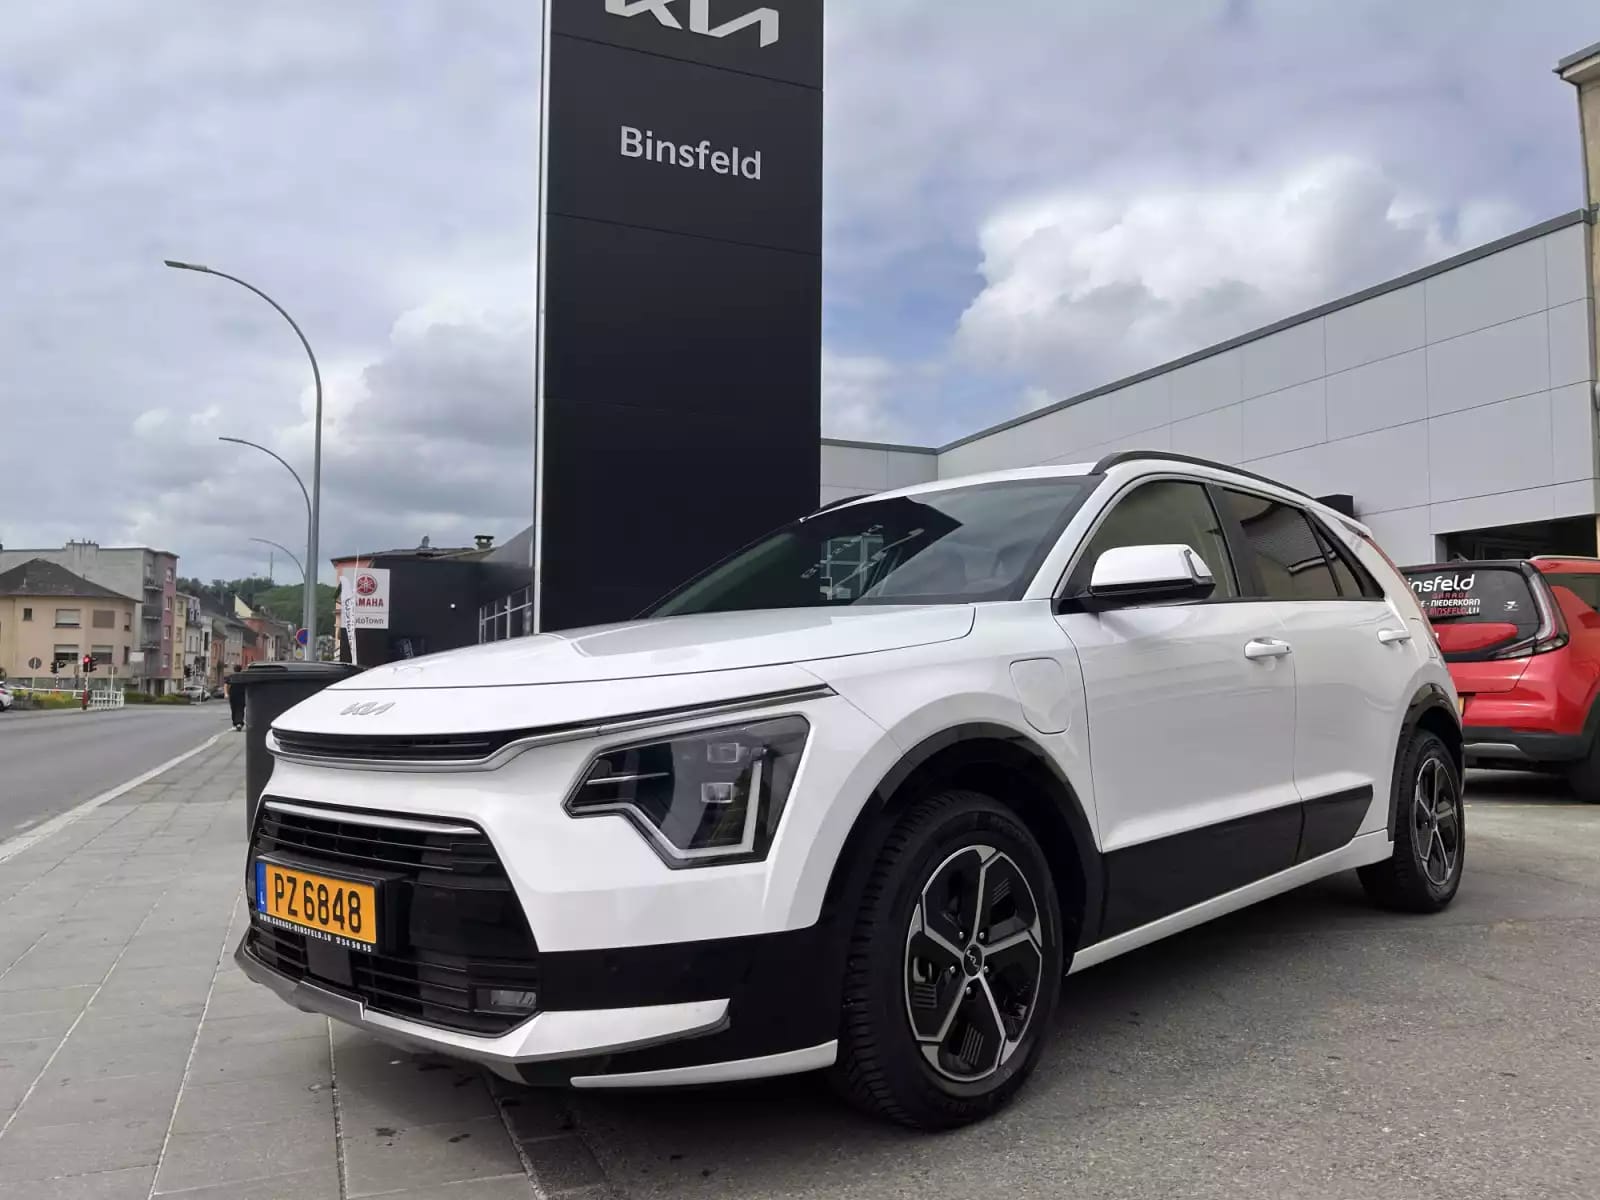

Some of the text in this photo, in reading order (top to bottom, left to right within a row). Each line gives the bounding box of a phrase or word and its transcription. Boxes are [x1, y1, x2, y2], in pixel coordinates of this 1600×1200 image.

[620, 125, 762, 180] Binsfeld
[1408, 574, 1475, 592] insfeld
[356, 598, 384, 607] MAHA
[1430, 598, 1481, 607] NIEDERKORN
